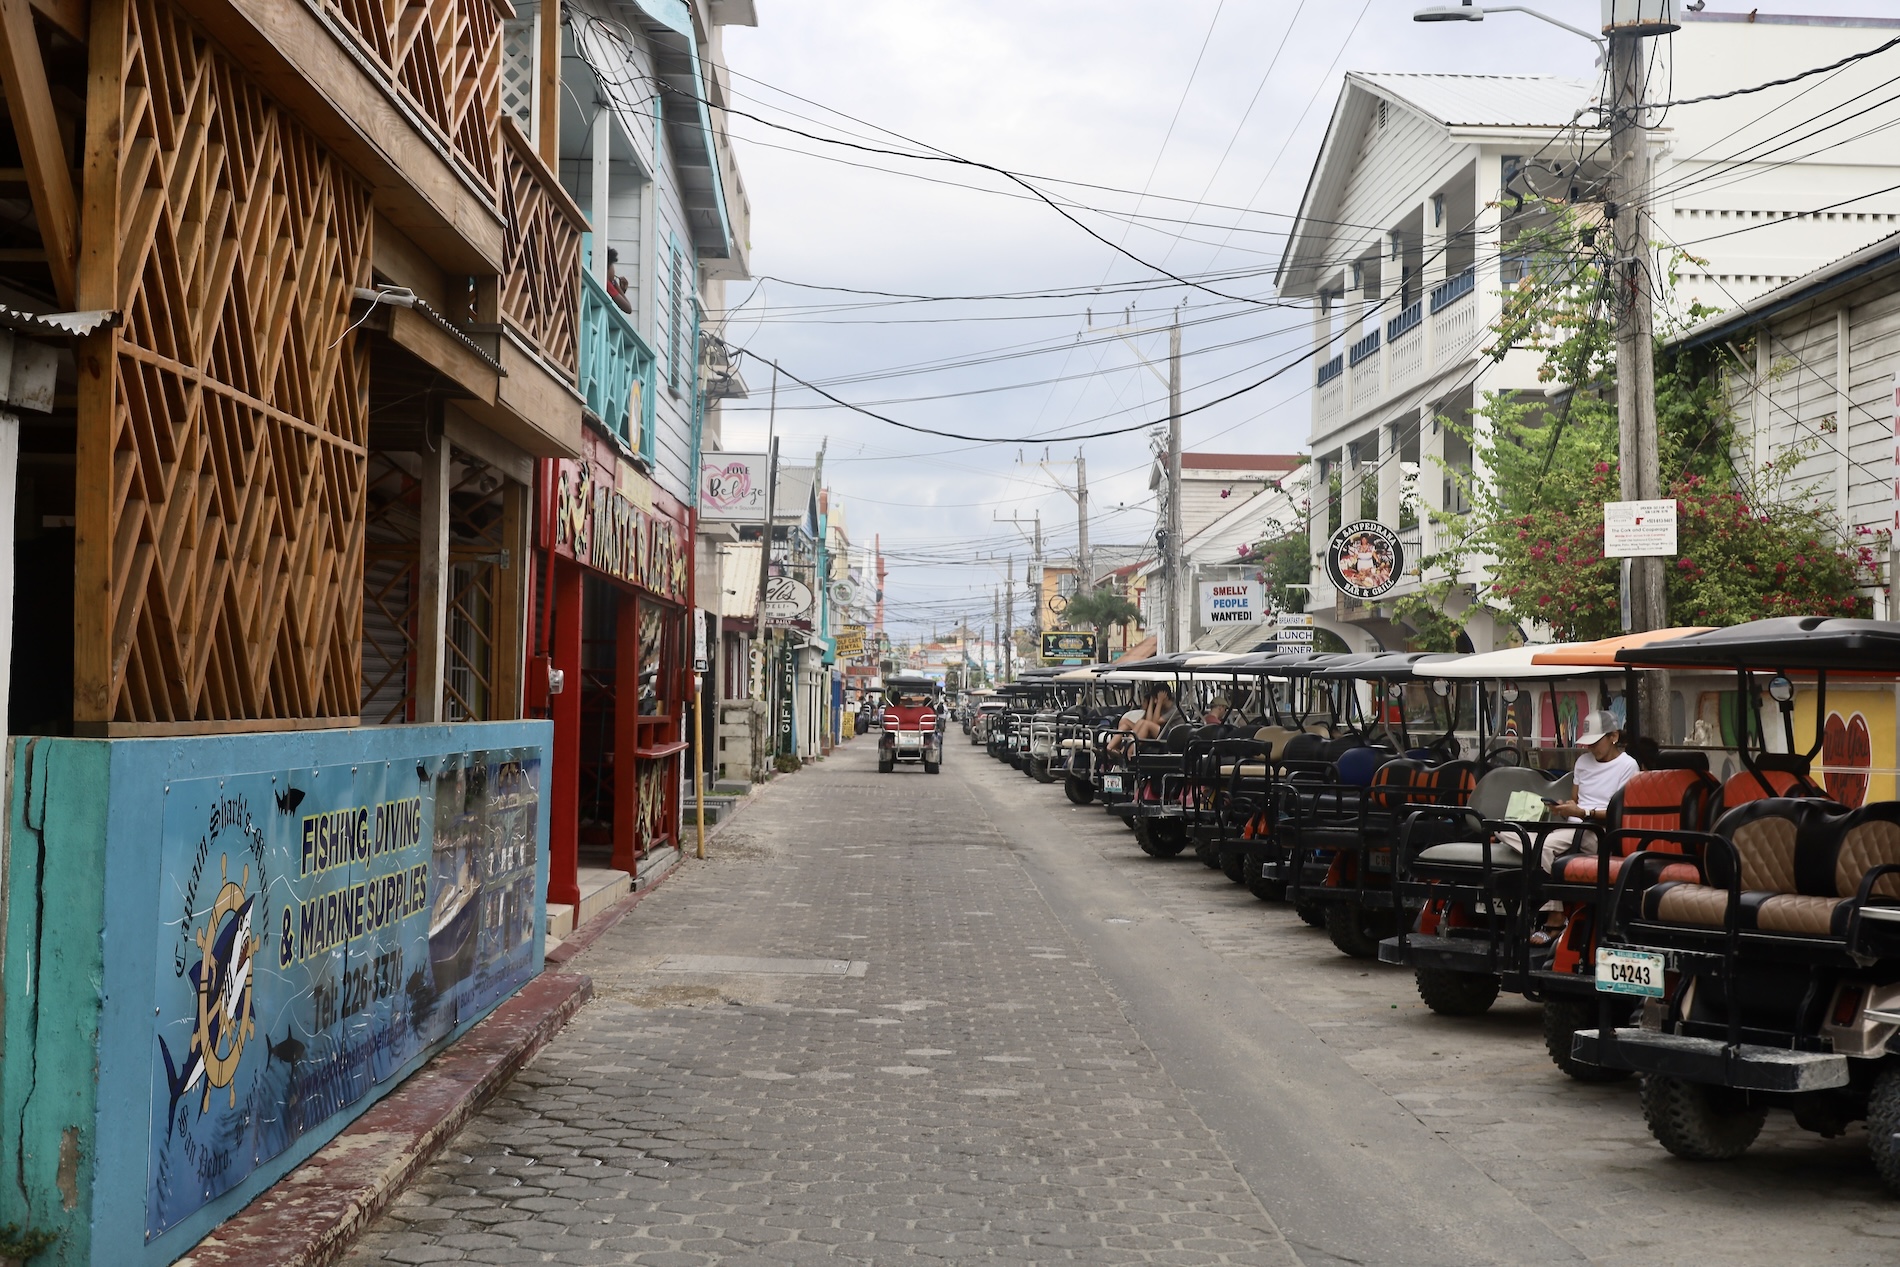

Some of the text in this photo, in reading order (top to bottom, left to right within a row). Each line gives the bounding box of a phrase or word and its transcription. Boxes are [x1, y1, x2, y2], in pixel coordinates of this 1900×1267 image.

[727, 466, 750, 475] LOVE
[709, 478, 765, 505] Belize
[1333, 522, 1397, 550] LA SANPEDRANA
[1213, 586, 1248, 596] SMELLY
[1344, 579, 1394, 597] BAR & GRILL
[1213, 598, 1248, 608] PEOPLE
[1279, 616, 1300, 624] BREAKFAST
[1278, 631, 1312, 640] LUNCH
[836, 643, 860, 651] RENTAL
[1278, 646, 1312, 654] DINNER
[782, 698, 792, 733] GIFT
[210, 793, 252, 845] Shark's
[301, 795, 421, 878] FISHING, DIVING
[279, 861, 427, 970] & MARINE SUPPLIES
[1611, 963, 1650, 985] C4243
[313, 975, 338, 1034] Tel:
